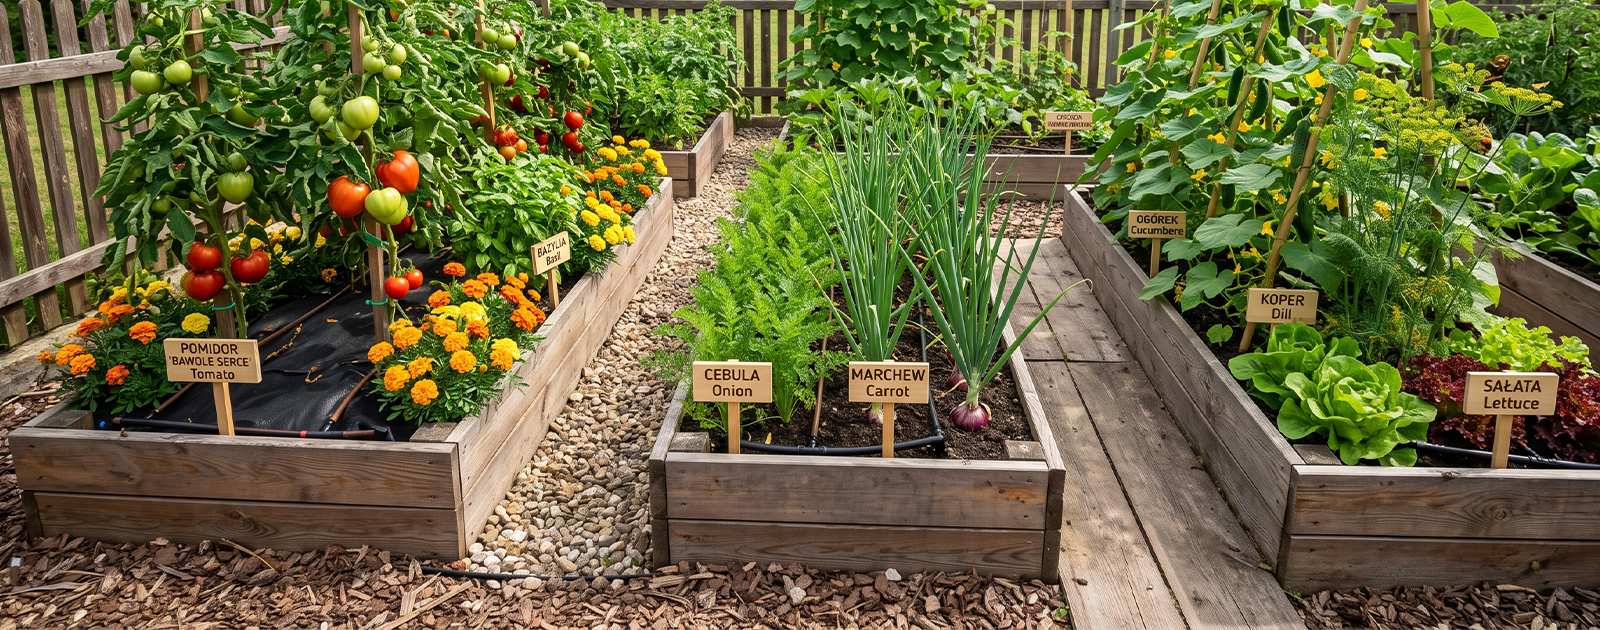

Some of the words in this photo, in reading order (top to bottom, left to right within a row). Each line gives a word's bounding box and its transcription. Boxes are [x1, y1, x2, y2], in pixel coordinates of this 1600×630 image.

[1136, 213, 1179, 225] OGÓREK
[1131, 225, 1184, 236] Cucumbere
[537, 237, 567, 258] BAZYLIA
[545, 250, 562, 266] Basil
[1261, 293, 1305, 306] KOPER
[1271, 308, 1292, 320] Dill
[180, 342, 239, 355] POMIDOR
[190, 368, 235, 380] Tomato
[704, 368, 760, 381] CEBULA
[851, 368, 926, 381] MARCHEW
[712, 384, 753, 397] Onion
[866, 384, 910, 397] Carrot
[1483, 379, 1542, 393] SAŁATA
[1483, 396, 1540, 410] Lettuce
